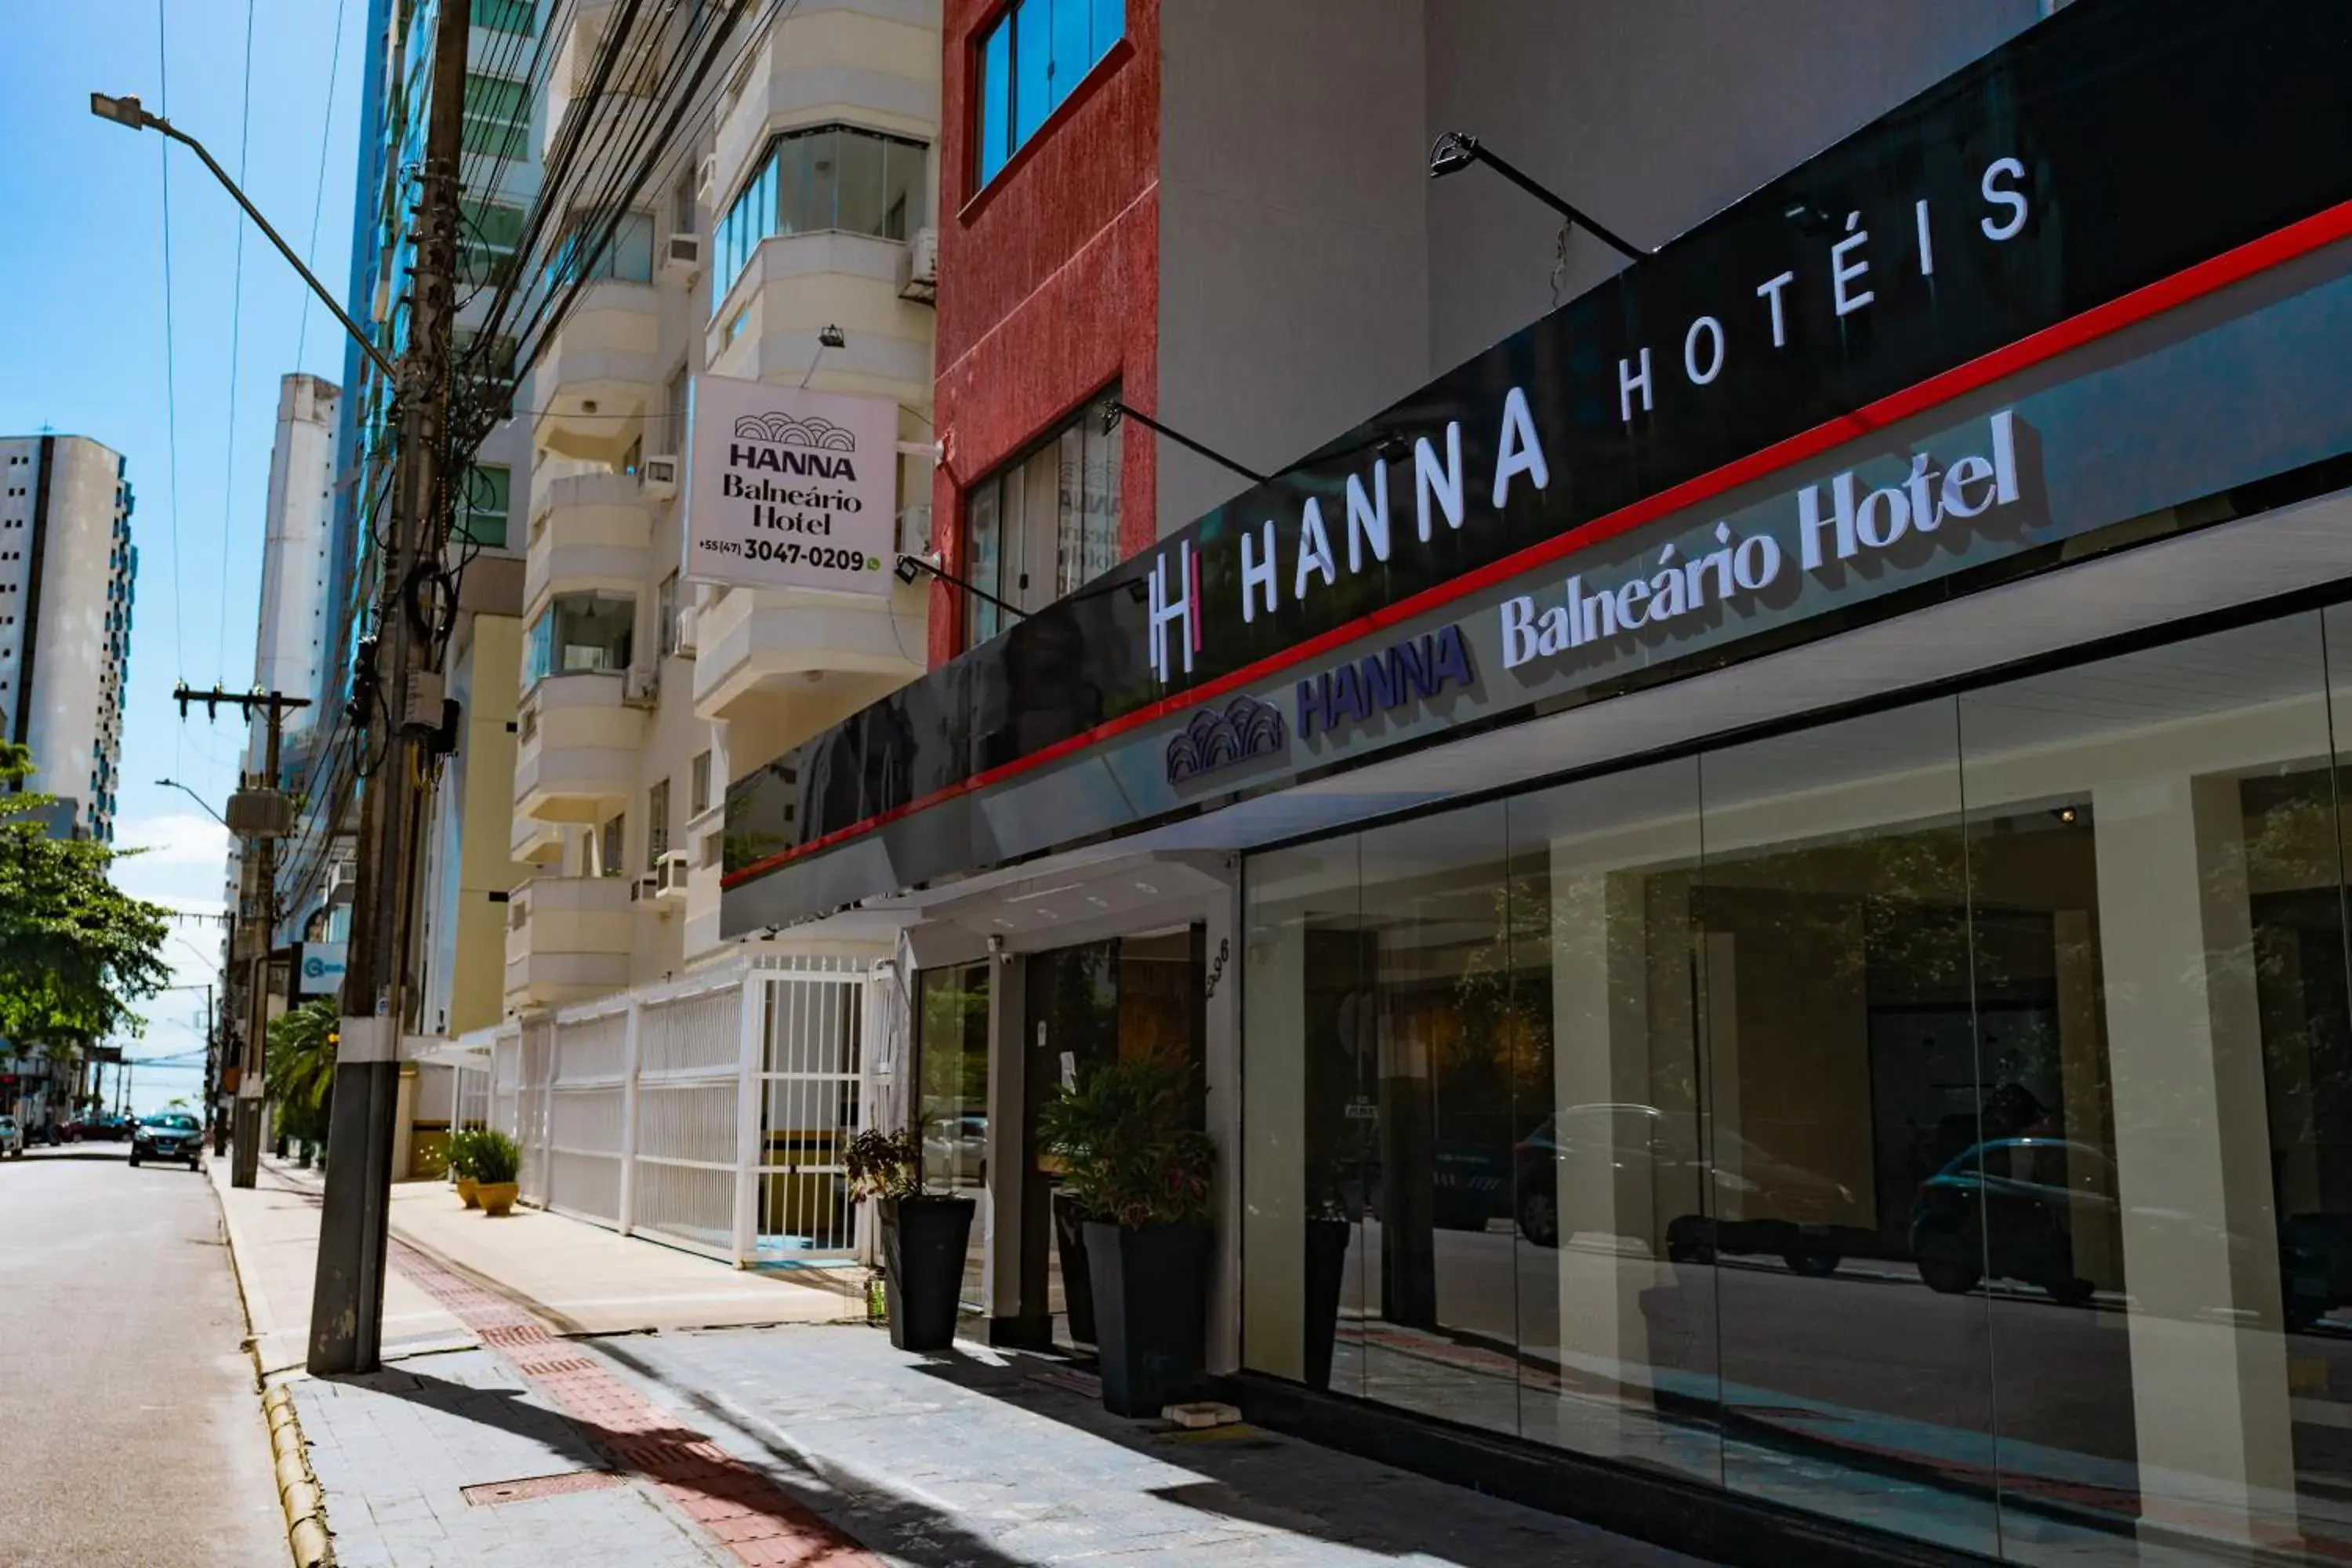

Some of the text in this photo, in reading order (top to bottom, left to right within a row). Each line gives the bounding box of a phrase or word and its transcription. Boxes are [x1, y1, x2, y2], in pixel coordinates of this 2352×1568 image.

[1241, 387, 1550, 624] HANNA
[1618, 157, 2029, 422] HOTÉIS
[730, 444, 857, 481] HANNA
[723, 474, 862, 514] Balneário
[753, 504, 831, 535] Hotel
[744, 539, 864, 572] 3047-0209
[1296, 410, 2020, 739] HANNA Balneário Hotel
